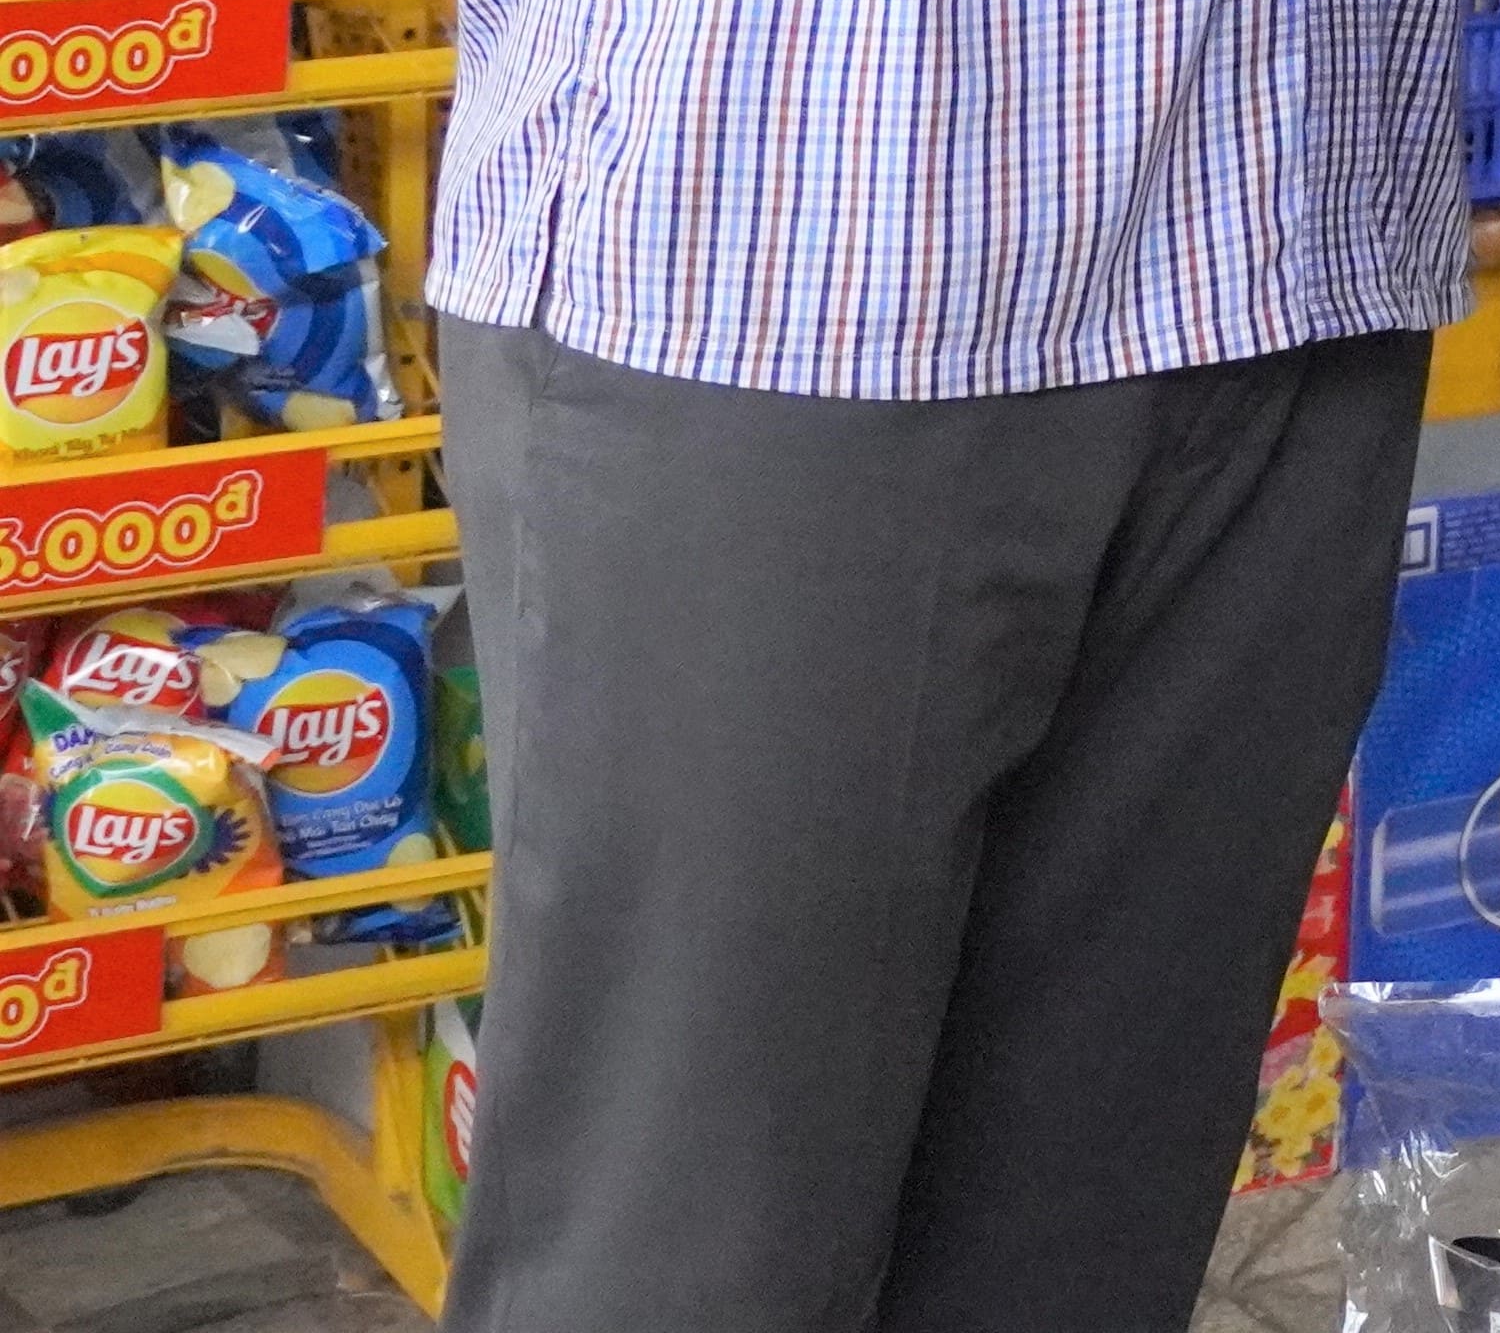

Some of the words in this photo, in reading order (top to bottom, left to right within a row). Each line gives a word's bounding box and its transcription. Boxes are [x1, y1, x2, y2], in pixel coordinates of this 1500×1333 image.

[14, 325, 142, 398] Lay's
[68, 633, 195, 704] Lay's
[268, 695, 383, 768] Lay's
[74, 805, 190, 863] Lay's
